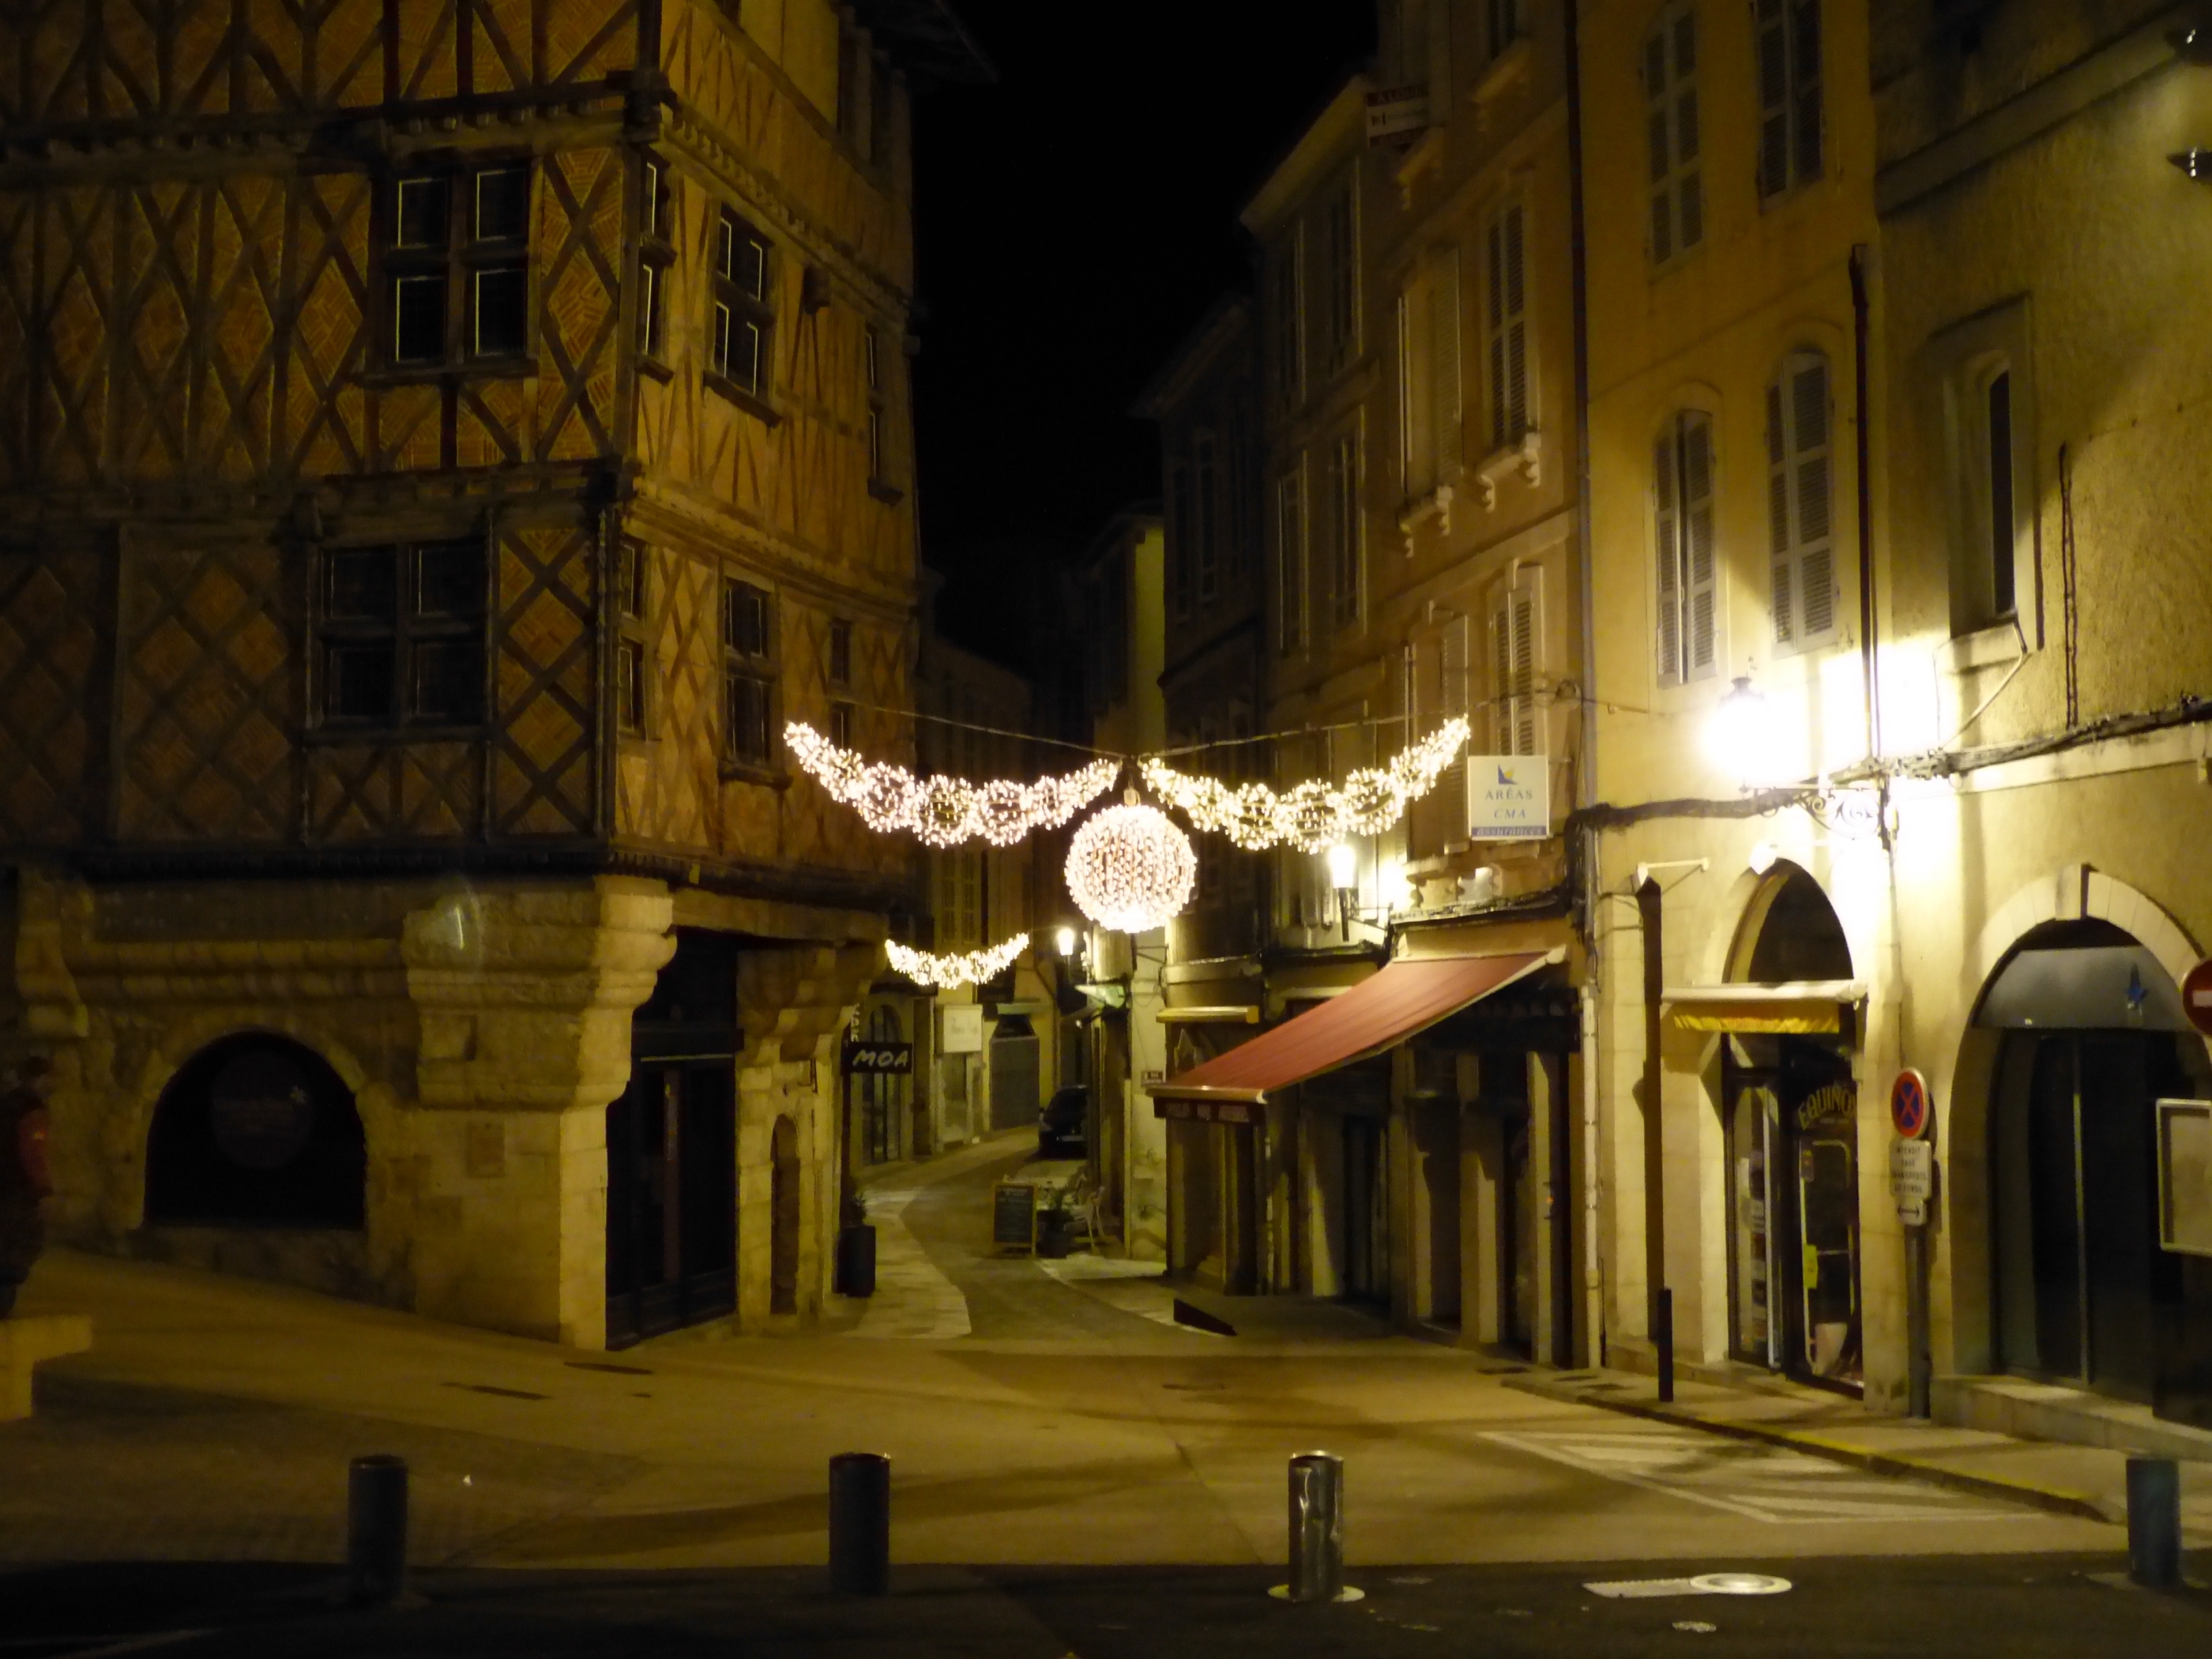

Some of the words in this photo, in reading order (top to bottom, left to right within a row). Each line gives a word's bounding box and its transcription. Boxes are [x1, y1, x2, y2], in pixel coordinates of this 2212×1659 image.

[1485, 788, 1533, 800] ARÉAS
[1494, 809, 1526, 819] CMA
[852, 1049, 908, 1067] MOA
